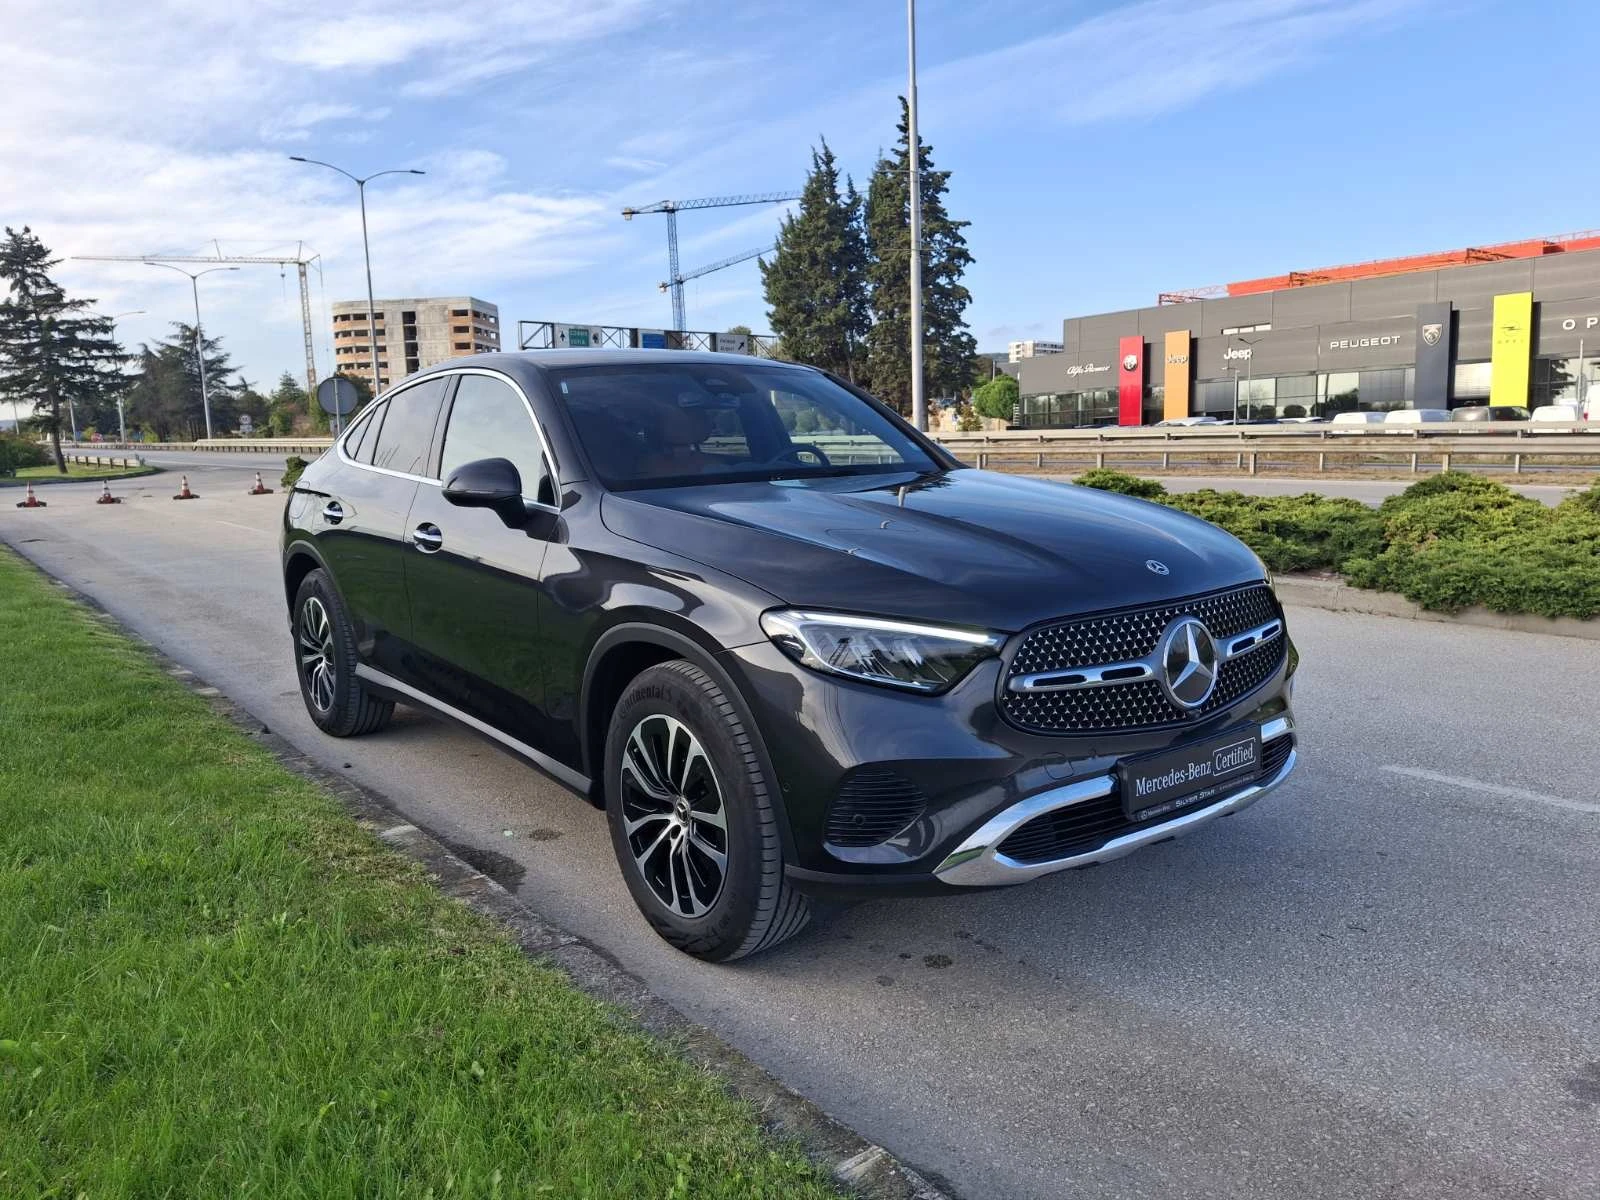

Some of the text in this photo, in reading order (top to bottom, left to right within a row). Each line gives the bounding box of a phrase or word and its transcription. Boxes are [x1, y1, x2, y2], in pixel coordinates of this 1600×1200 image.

[1330, 335, 1401, 350] PEUGEOT
[1168, 353, 1188, 364] Jeep
[1223, 347, 1253, 360] Jeep
[1136, 761, 1212, 796] Mercedes-Benz
[1215, 743, 1253, 771] Certified
